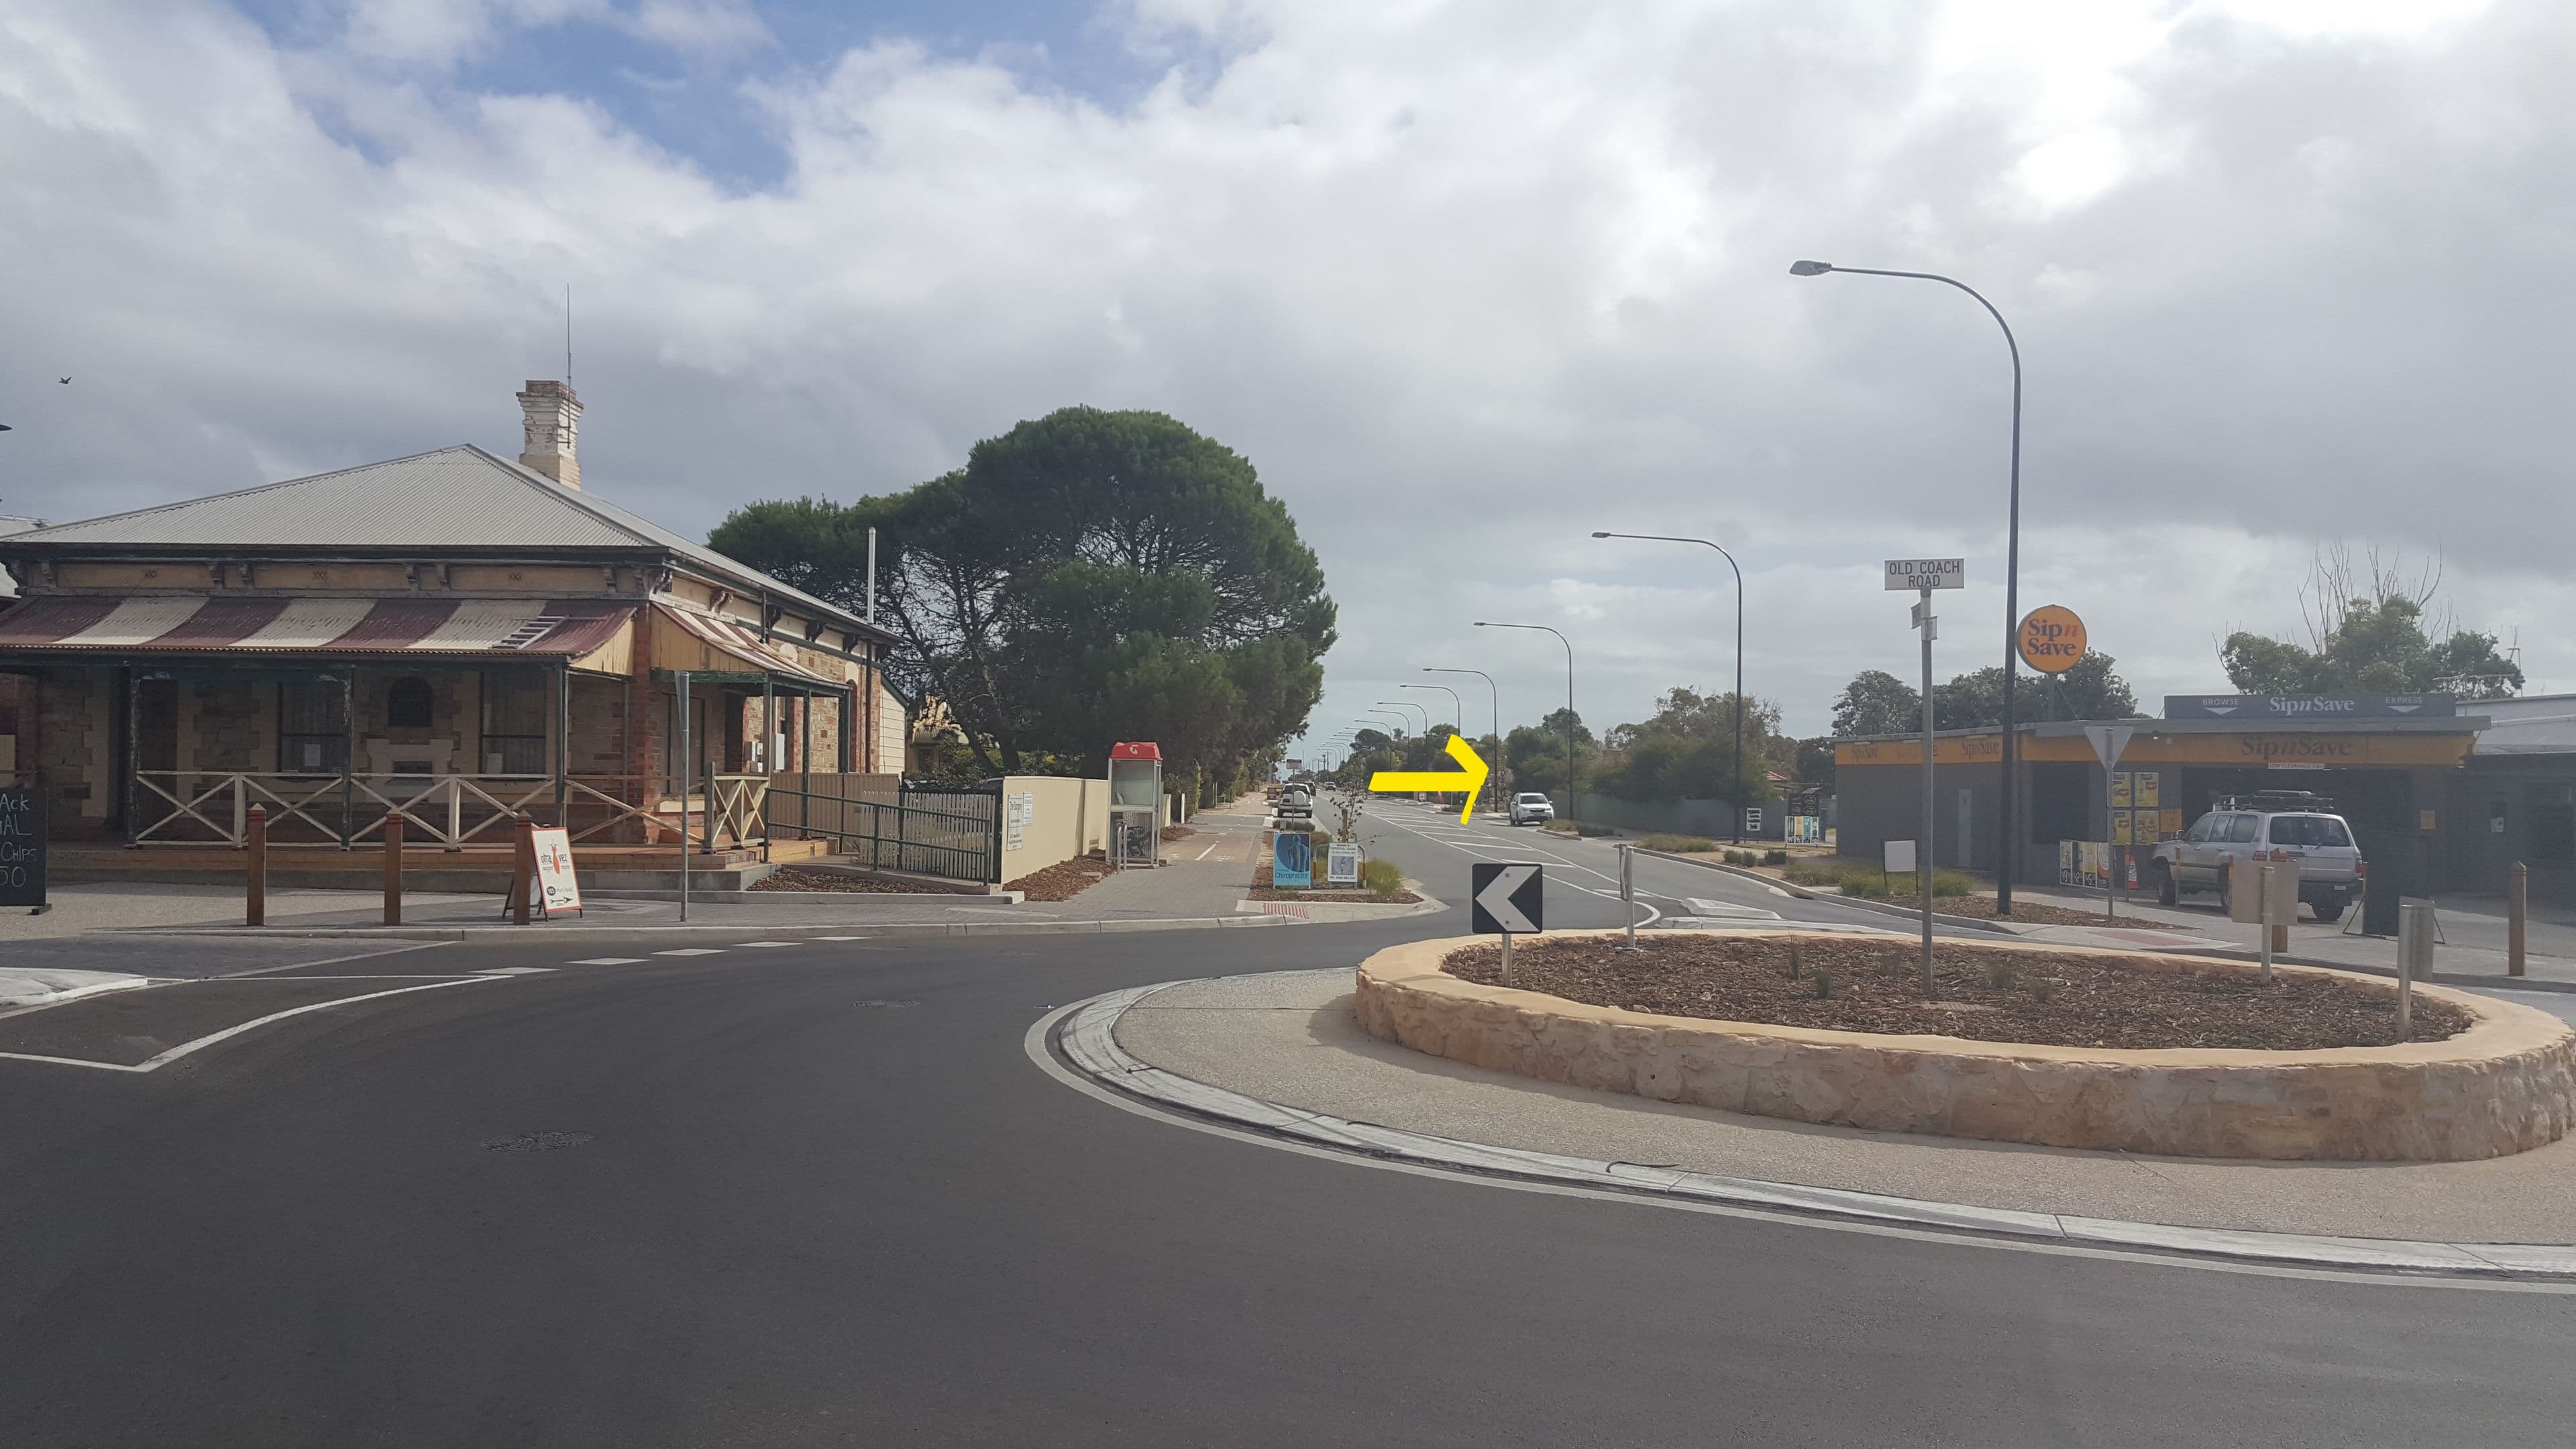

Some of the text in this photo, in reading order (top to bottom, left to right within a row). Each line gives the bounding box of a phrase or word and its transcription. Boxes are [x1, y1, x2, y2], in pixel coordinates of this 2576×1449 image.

[1889, 561, 1960, 575] OLD COACH
[1908, 574, 1941, 588] ROAD
[2027, 638, 2077, 656] Save
[2202, 698, 2239, 706] BROWSE
